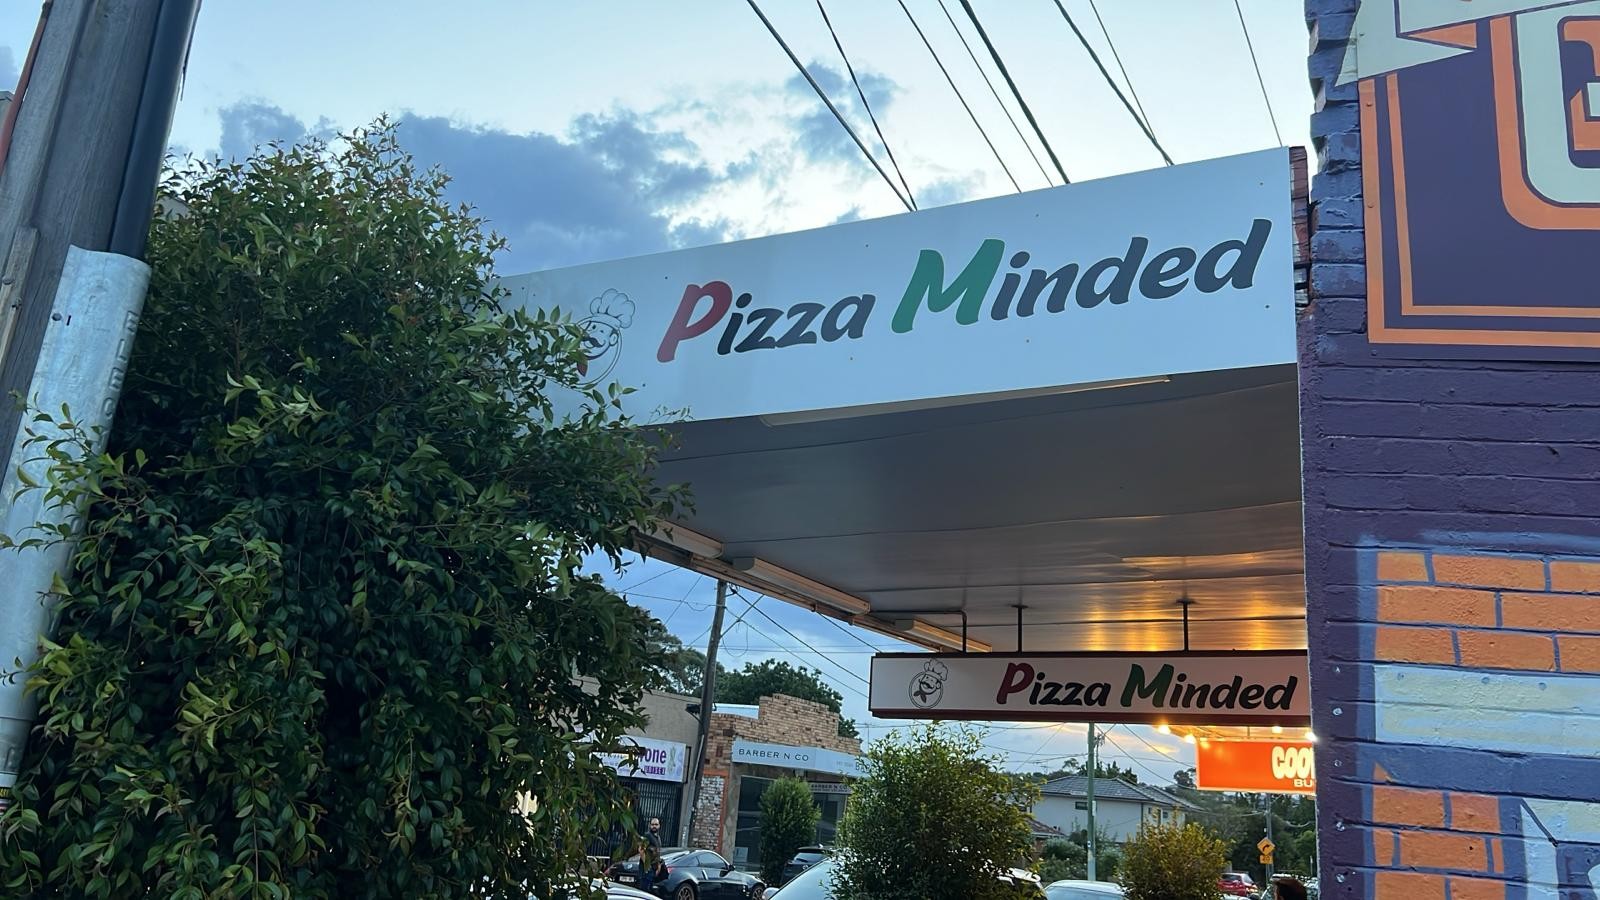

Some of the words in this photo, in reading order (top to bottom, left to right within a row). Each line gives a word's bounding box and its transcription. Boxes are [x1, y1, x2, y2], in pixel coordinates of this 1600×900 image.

[656, 280, 877, 363] Pizza
[890, 218, 1273, 334] Minded
[996, 662, 1112, 707] Pizza
[1120, 663, 1298, 710] Minded
[738, 747, 780, 759] BARBER
[783, 751, 791, 760] N
[794, 753, 810, 762] CO
[1293, 778, 1313, 788] BU
